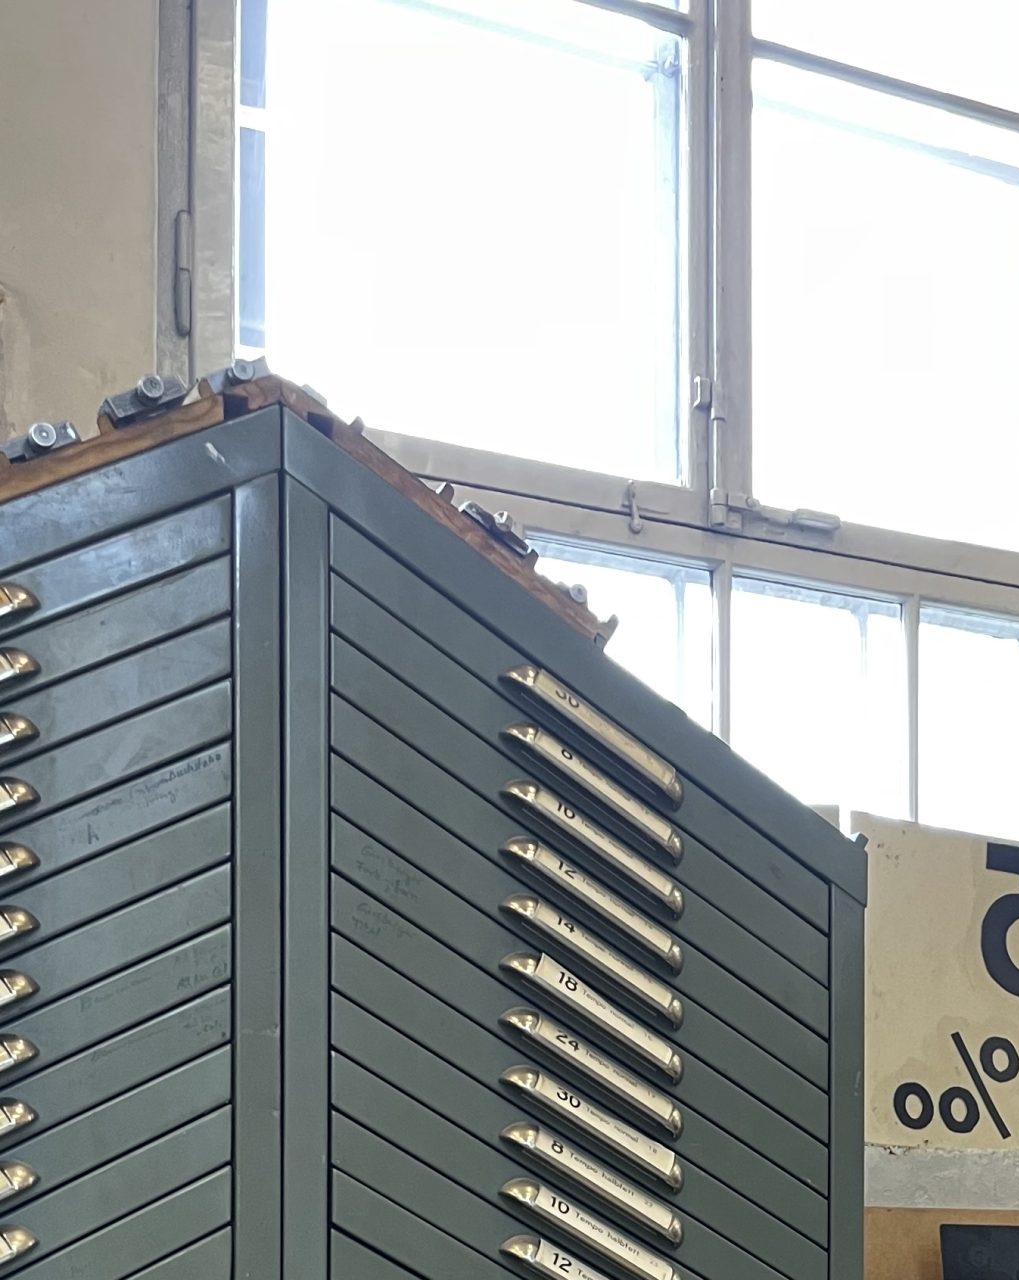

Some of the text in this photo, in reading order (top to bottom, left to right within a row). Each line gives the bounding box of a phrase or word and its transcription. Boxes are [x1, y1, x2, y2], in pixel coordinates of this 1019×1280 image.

[557, 803, 575, 821] 10
[558, 861, 576, 879] 12
[557, 917, 575, 933] 14
[558, 971, 578, 993] 18
[582, 990, 606, 1010] Tempo
[556, 1030, 579, 1052] 24
[586, 1050, 610, 1069] Tempo
[613, 1068, 637, 1086] normal
[556, 1087, 581, 1110] 30
[586, 1107, 611, 1126] Tempo
[613, 1124, 638, 1141] normal
[551, 1140, 564, 1155] 8
[570, 1153, 598, 1174] Tempo
[601, 1173, 634, 1196] halbfett
[551, 1196, 570, 1216] 10
[576, 1213, 603, 1234] Tempo
[607, 1232, 640, 1255] halbfett
[553, 1252, 572, 1274] 12
